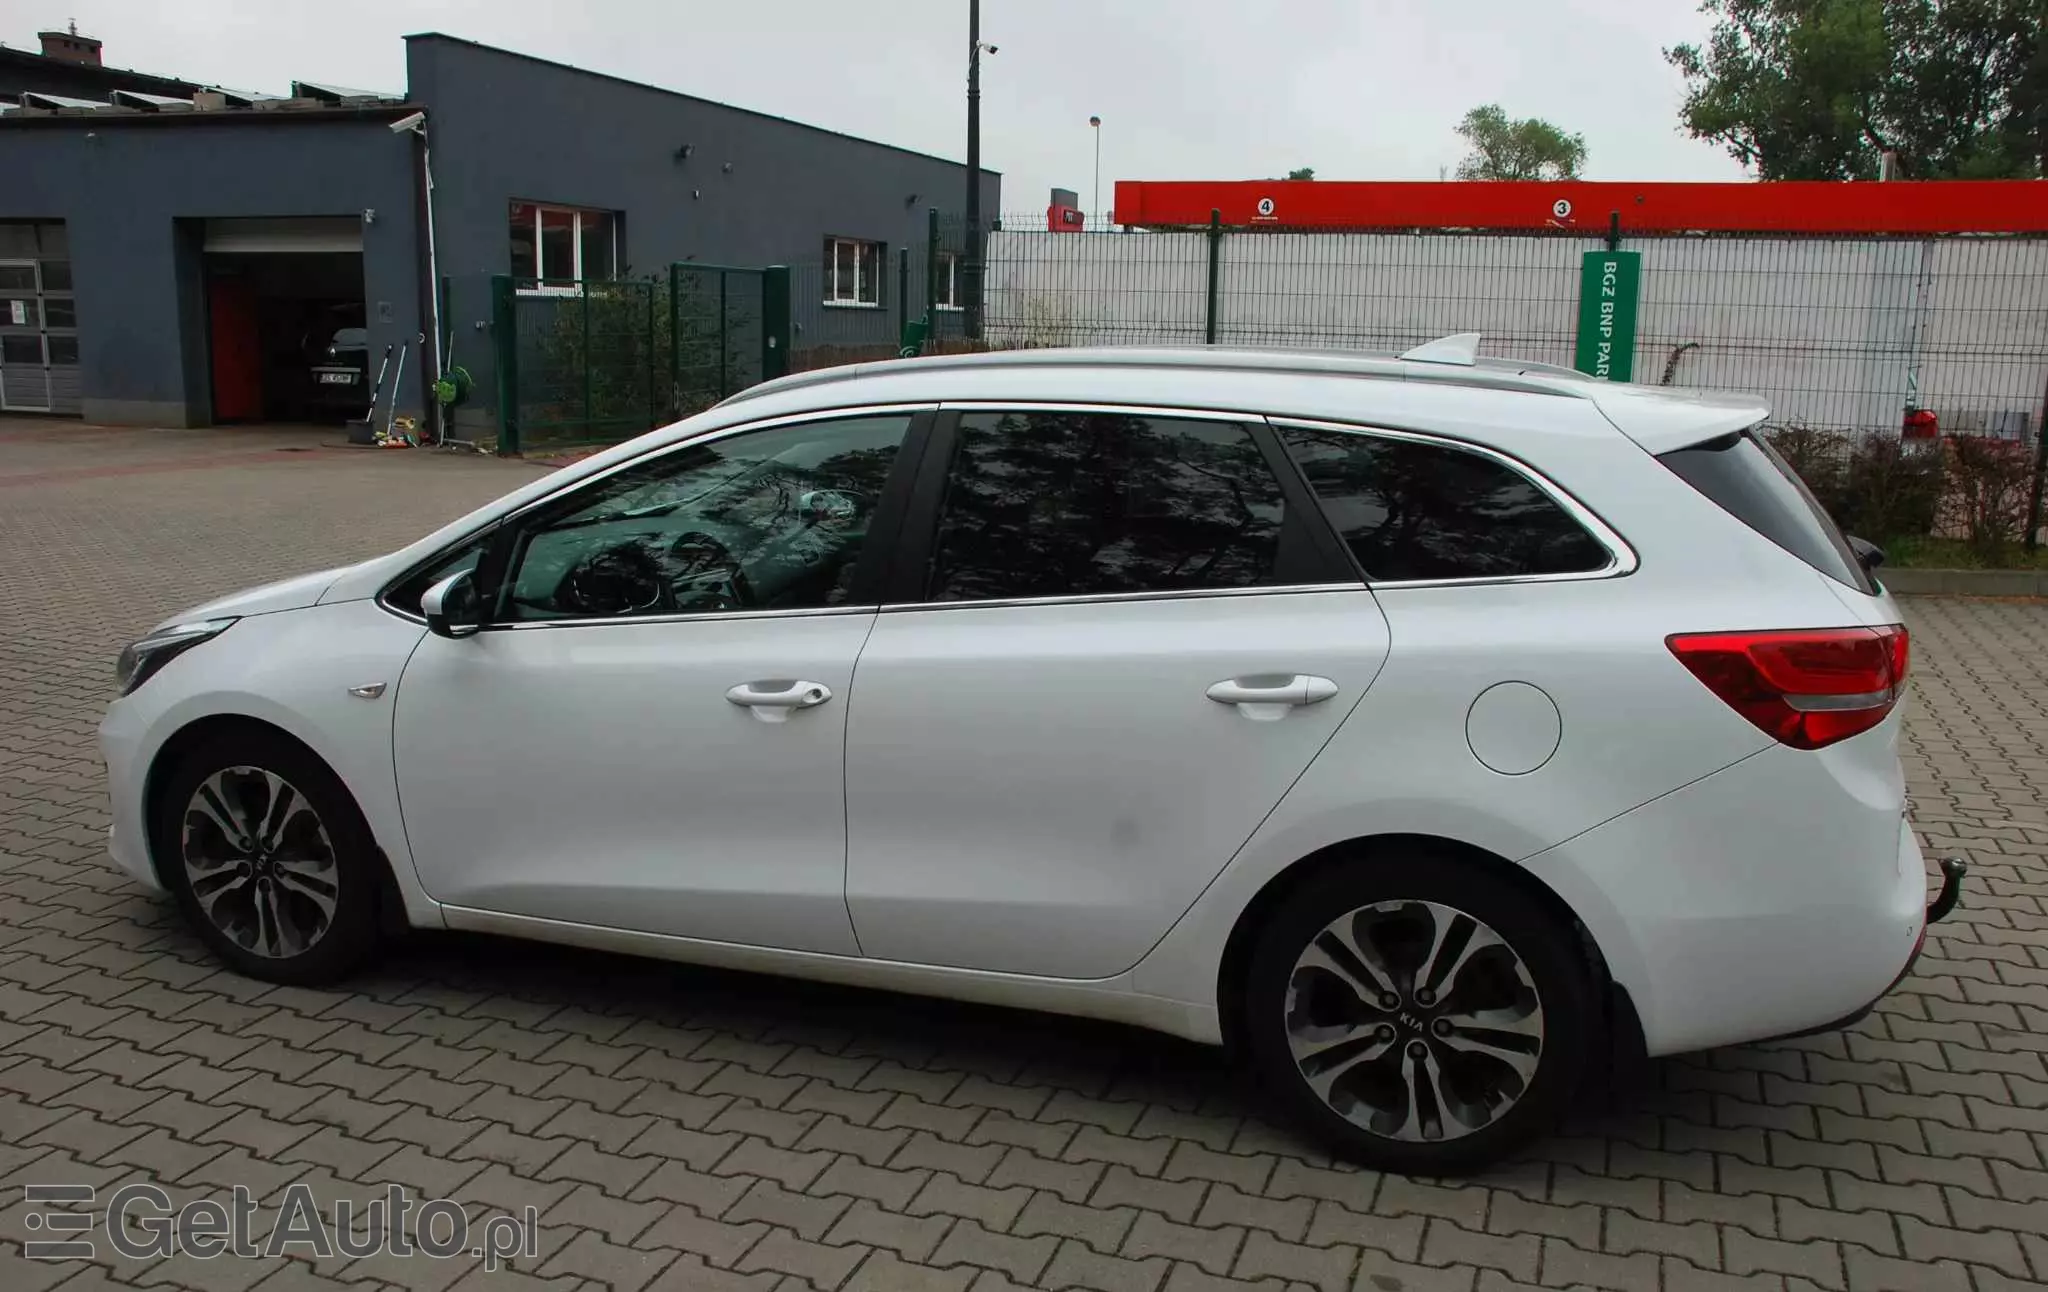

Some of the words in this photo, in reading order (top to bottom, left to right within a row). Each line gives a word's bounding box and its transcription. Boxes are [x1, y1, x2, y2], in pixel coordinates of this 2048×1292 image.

[1261, 200, 1270, 212] 4
[1557, 202, 1567, 214] 3
[1599, 302, 1614, 338] BNP
[1400, 1012, 1423, 1032] KIA
